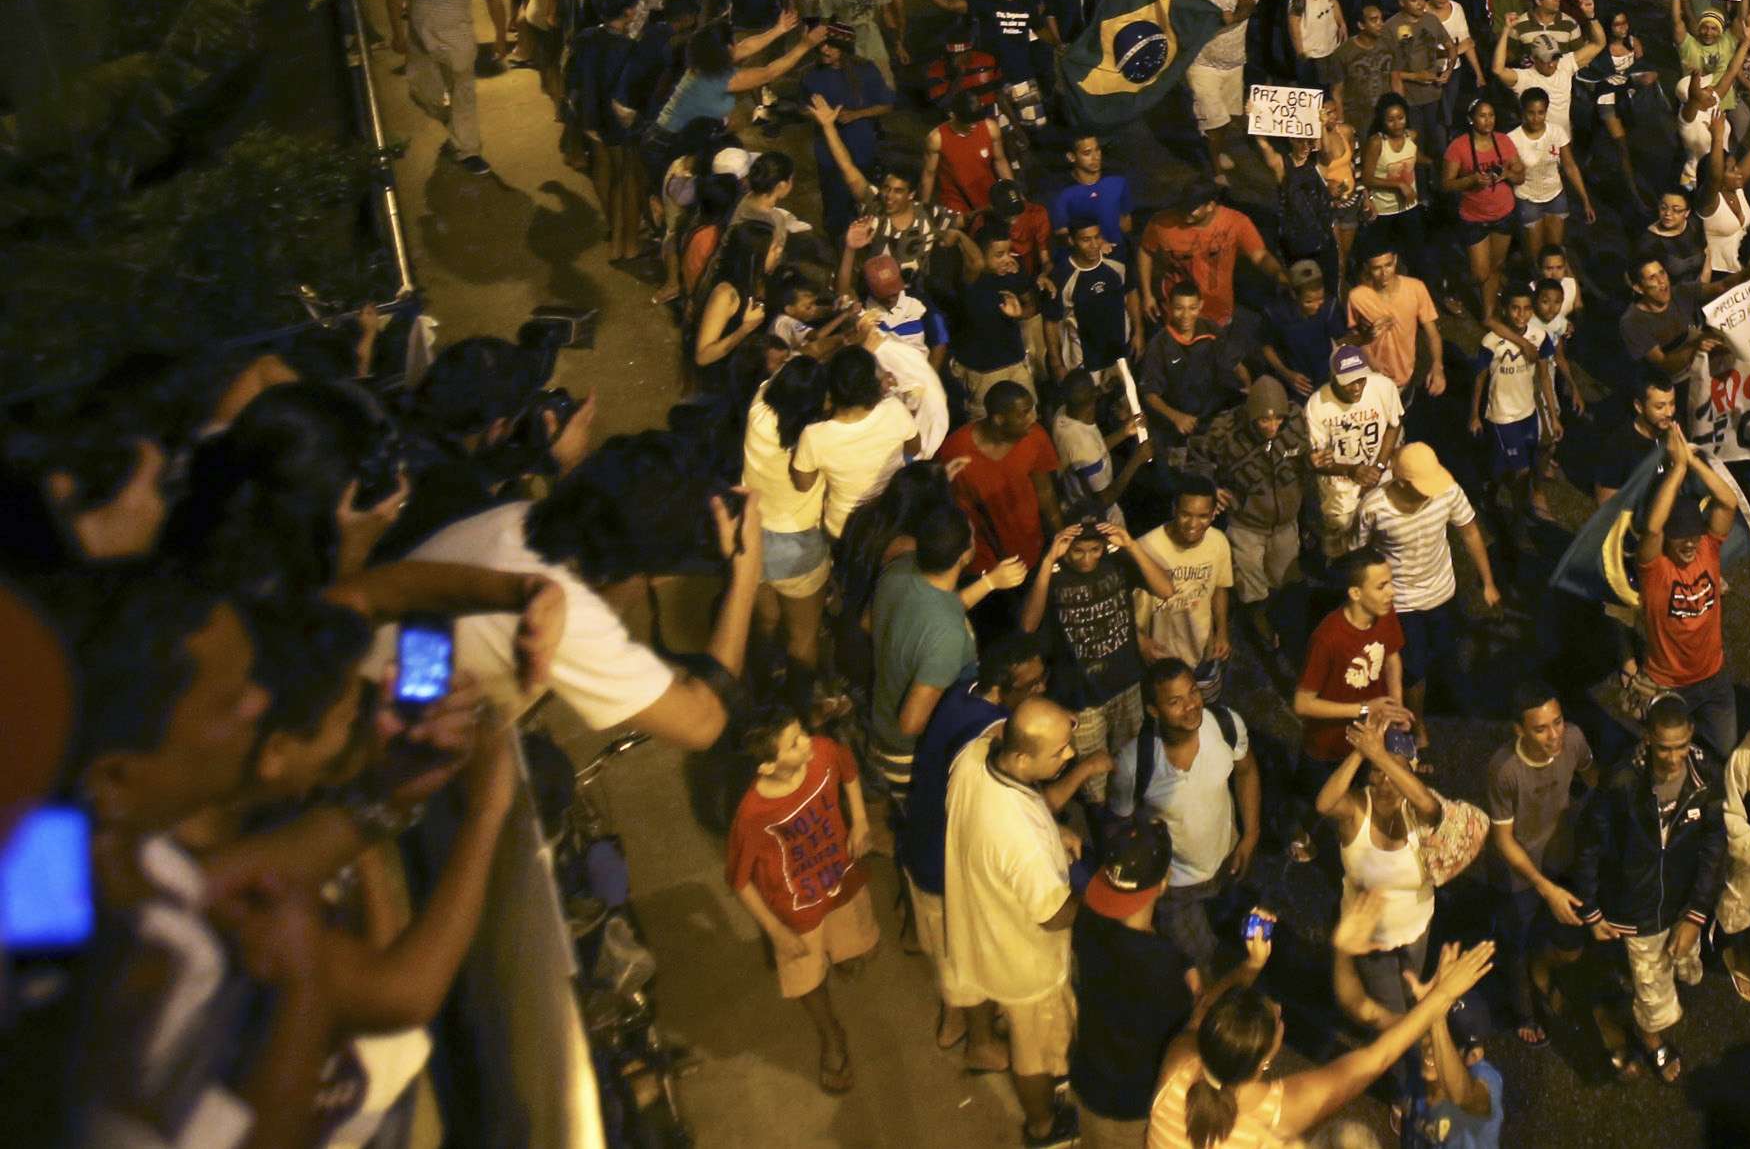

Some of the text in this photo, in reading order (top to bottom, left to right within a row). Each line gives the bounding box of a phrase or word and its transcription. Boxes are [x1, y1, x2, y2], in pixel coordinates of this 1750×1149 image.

[1253, 87, 1322, 109] PAZ SEM
[1269, 105, 1299, 120] VOZ
[1273, 119, 1314, 136] MEDO
